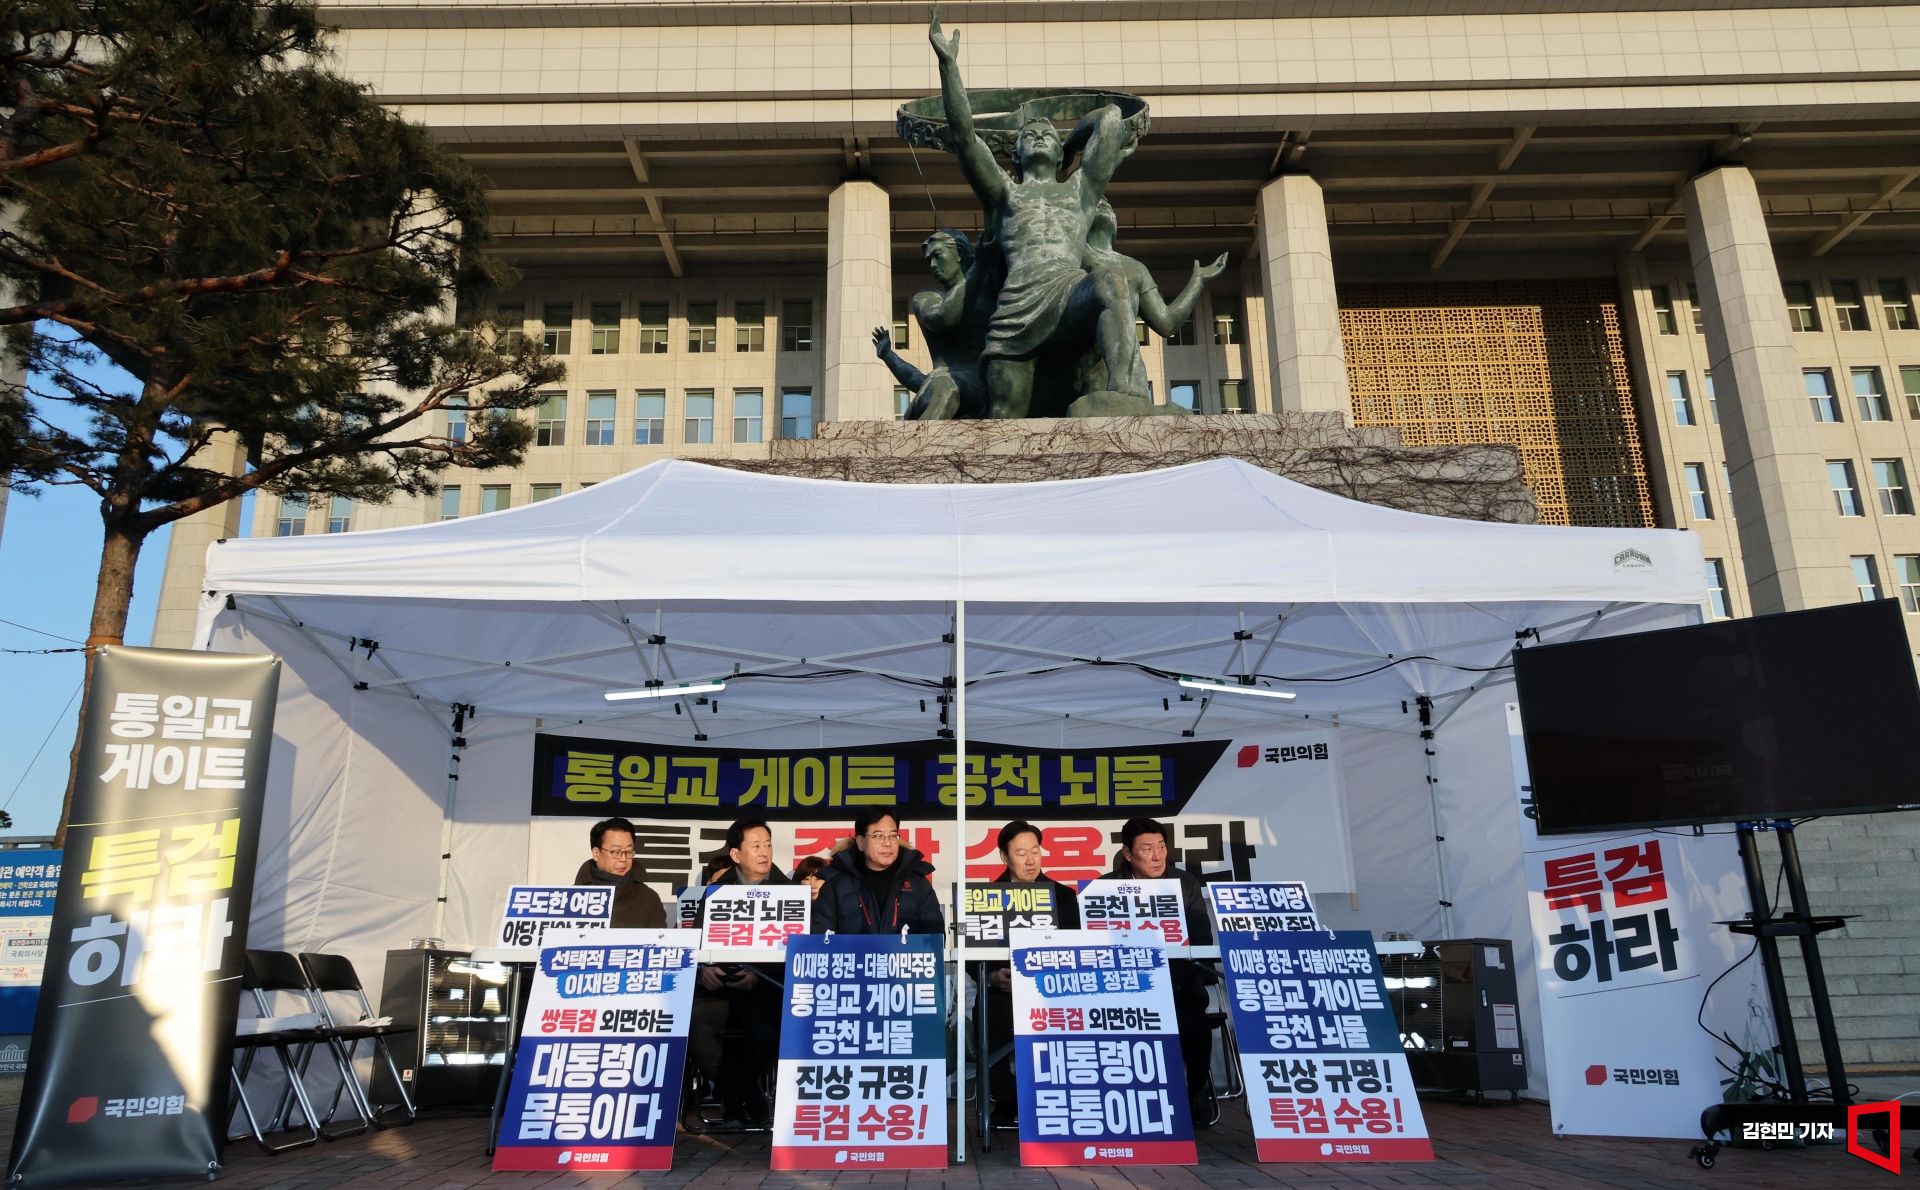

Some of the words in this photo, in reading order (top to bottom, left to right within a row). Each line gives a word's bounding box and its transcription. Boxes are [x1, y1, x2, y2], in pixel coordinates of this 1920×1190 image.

[110, 691, 253, 741] 통일교
[1265, 743, 1329, 763] 국민의힘
[100, 742, 246, 790] 게이트
[565, 751, 719, 806] 통일교
[739, 756, 896, 807] 게이트
[937, 754, 1042, 806] 공천
[1060, 755, 1163, 806] 뇌물
[81, 819, 240, 902] 특검
[1543, 840, 1669, 912] 특검
[1006, 888, 1053, 912] 게이트
[1117, 886, 1141, 894] 민주당
[1215, 888, 1270, 911] 무도한
[1269, 887, 1306, 910] 여당
[511, 891, 568, 915] 무도한
[569, 891, 610, 915] 여당
[710, 900, 755, 921] 공천
[760, 900, 806, 921] 뇌물
[1084, 896, 1129, 918] 공천
[1135, 895, 1178, 917] 뇌물
[68, 897, 233, 986] 하라
[502, 920, 537, 947] 야당
[708, 924, 754, 946] 특검
[759, 924, 805, 946] 수용
[1549, 907, 1679, 985] 하라
[551, 949, 604, 971] 선택적
[608, 949, 642, 970] 특검
[648, 948, 684, 968] 남발
[793, 953, 829, 978] 이재명
[1024, 949, 1076, 970] 선택적
[1080, 949, 1115, 969] 특검
[1118, 948, 1153, 968] 남발
[1229, 949, 1266, 974] 이재명
[564, 972, 620, 993] 이재명
[624, 971, 663, 992] 정권
[1043, 972, 1097, 993] 이재명
[1103, 971, 1140, 991] 정권
[791, 984, 861, 1017] 통일교
[866, 983, 937, 1015] 게이트
[1234, 979, 1309, 1012] 통일교
[1312, 979, 1384, 1012] 게이트
[541, 1009, 596, 1033] 쌍특검
[600, 1009, 674, 1033] 외면하는
[1029, 1008, 1084, 1031] 쌍특검
[1089, 1008, 1161, 1030] 외면하는
[1265, 1015, 1317, 1049] 공천
[1317, 1014, 1369, 1049] 뇌물
[812, 1021, 860, 1054] 공천
[865, 1021, 913, 1054] 뇌물
[529, 1043, 668, 1088] 대통령이
[1032, 1040, 1167, 1085] 대통령이
[795, 1066, 853, 1099] 진상
[858, 1065, 927, 1099] 규명!
[1260, 1060, 1317, 1093] 진상
[1324, 1059, 1392, 1093] 규명!
[1613, 1067, 1680, 1087] 국민의힘
[105, 1095, 184, 1118] 국민의힘
[518, 1093, 662, 1140] 몸통이다
[1035, 1088, 1175, 1136] 몸통이다
[1269, 1098, 1328, 1134] 특검
[1333, 1097, 1405, 1134] 수용!
[793, 1105, 850, 1141] 특검
[857, 1104, 927, 1141] 수용!
[573, 1152, 609, 1163] 국민의힘
[850, 1152, 885, 1162] 국민의힘
[1099, 1147, 1134, 1158] 국민의힘
[1335, 1144, 1370, 1155] 국민의힘
